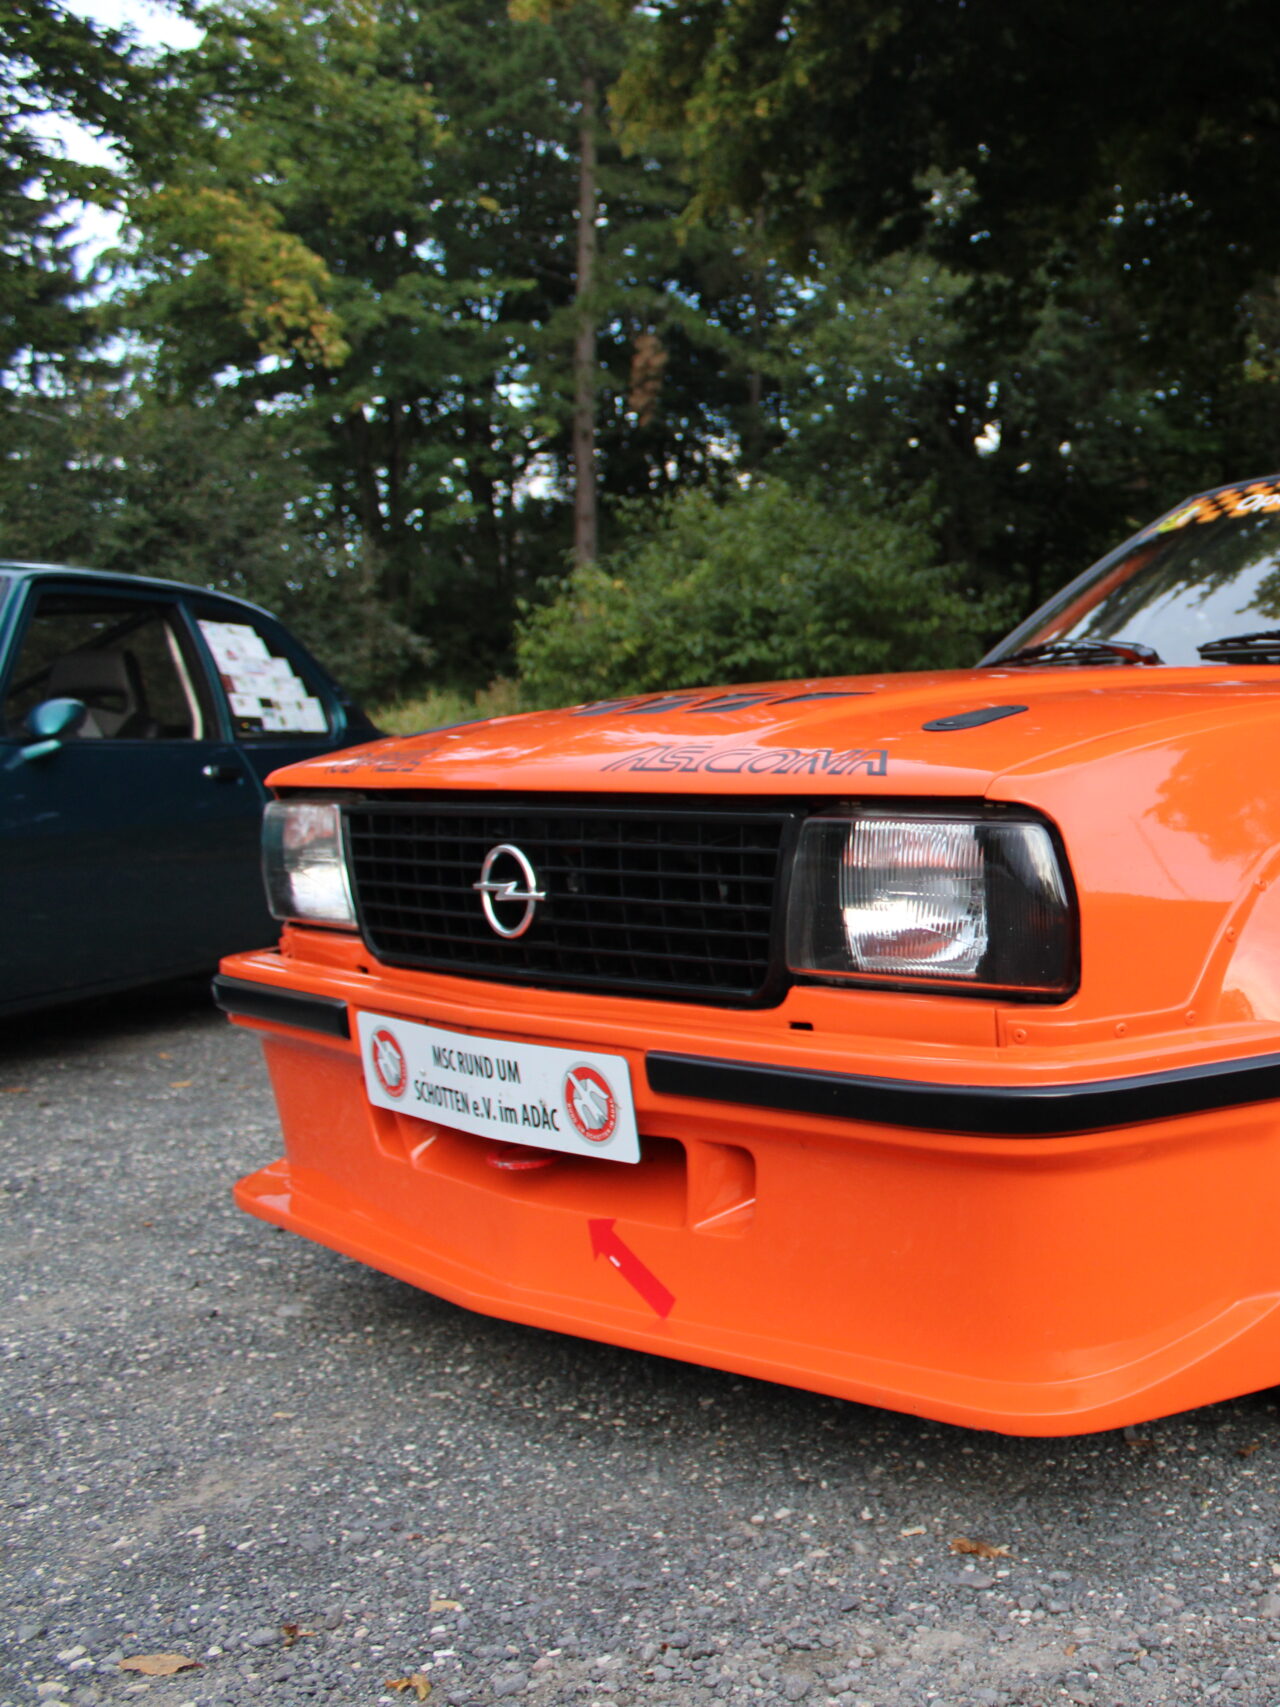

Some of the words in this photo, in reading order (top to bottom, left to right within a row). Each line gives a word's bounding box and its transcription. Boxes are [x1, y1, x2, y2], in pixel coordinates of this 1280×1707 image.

[431, 1045, 456, 1072] MSC
[457, 1051, 494, 1079] RUND
[496, 1058, 521, 1085] UM
[414, 1079, 470, 1115] SCHOTTEN
[472, 1096, 497, 1120] e.V.
[498, 1099, 519, 1125] im
[522, 1103, 560, 1132] ADAC
